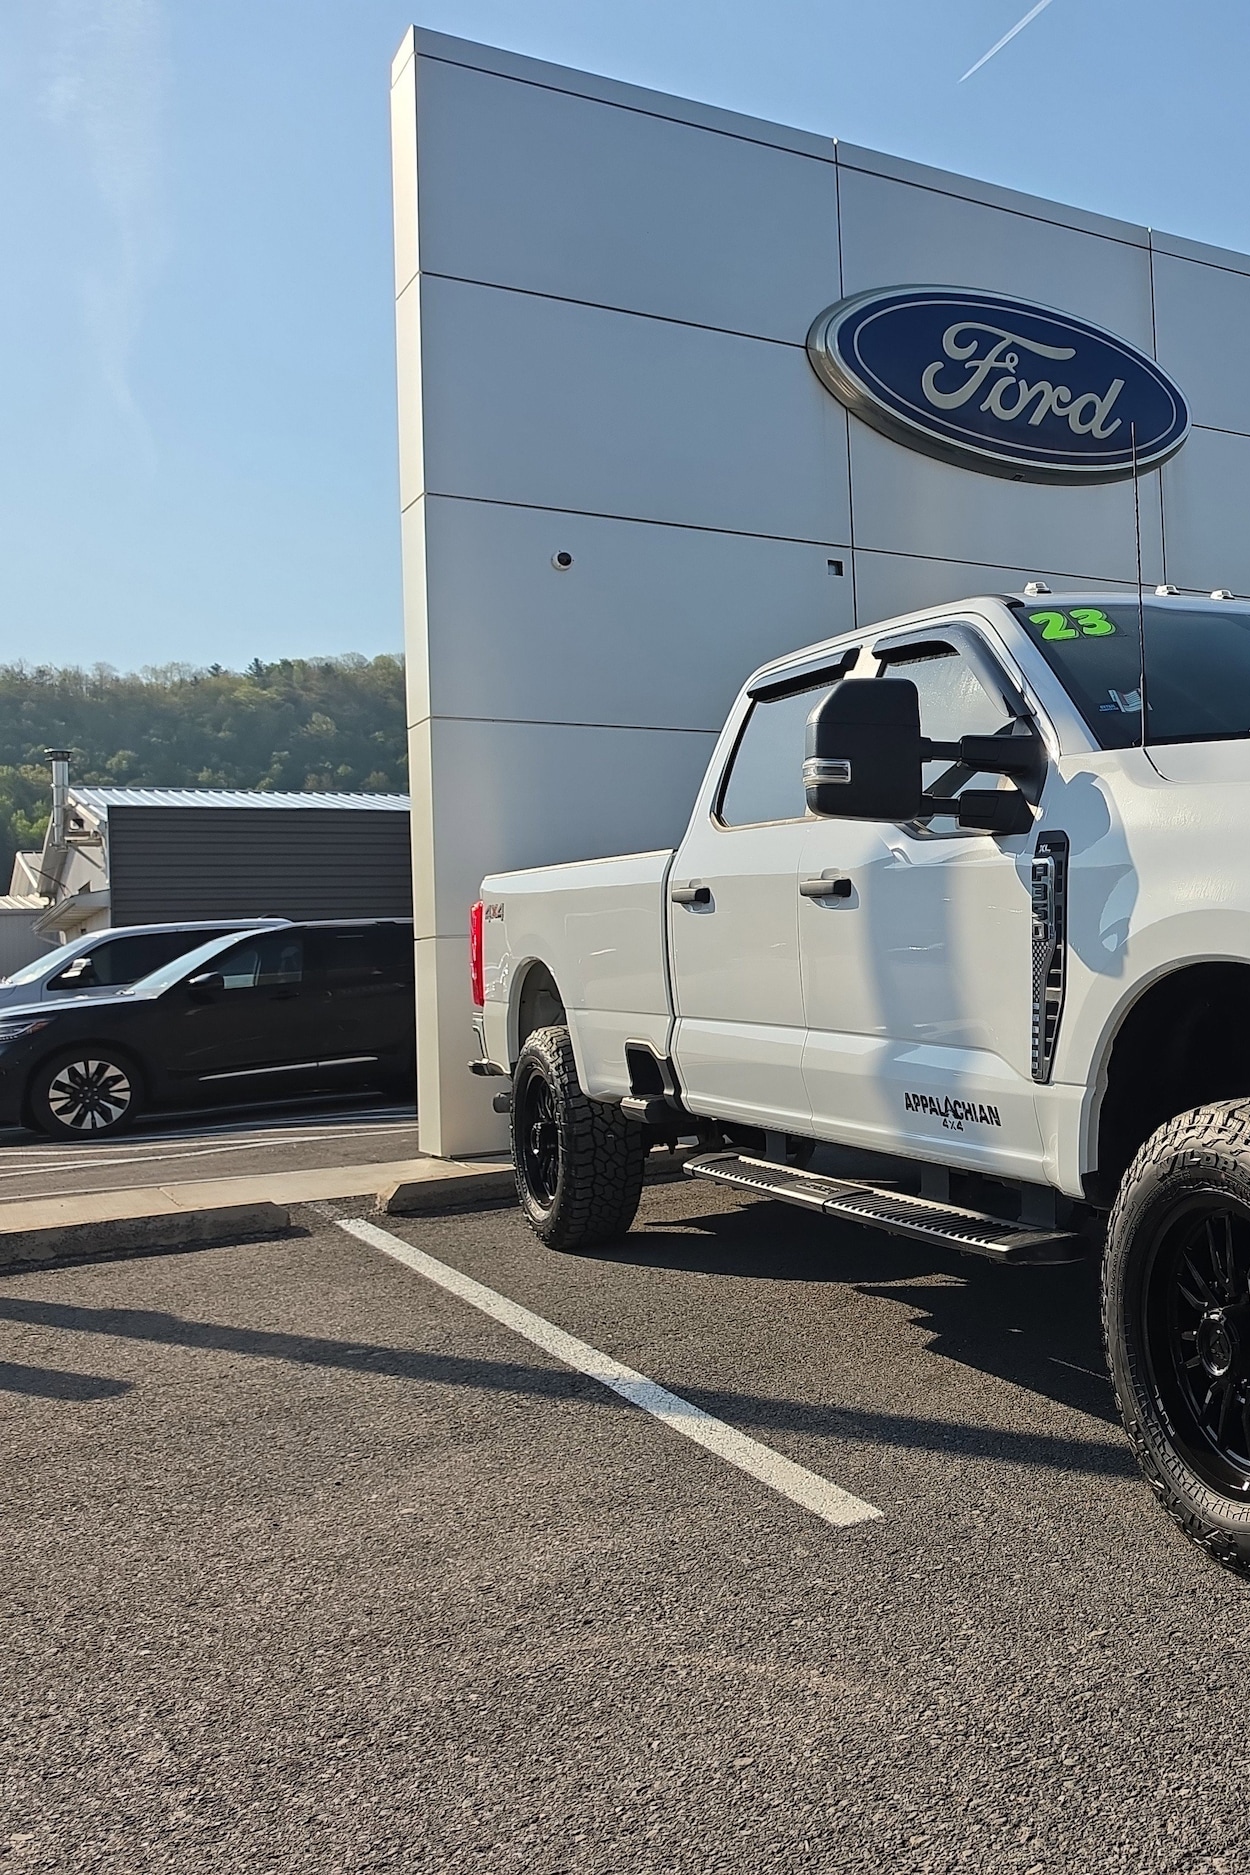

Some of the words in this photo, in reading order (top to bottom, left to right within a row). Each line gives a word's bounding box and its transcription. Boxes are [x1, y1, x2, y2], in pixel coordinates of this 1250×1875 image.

[921, 321, 1125, 439] Ford
[1028, 607, 1117, 642] 23
[904, 1091, 1002, 1128] APPALACHIAN
